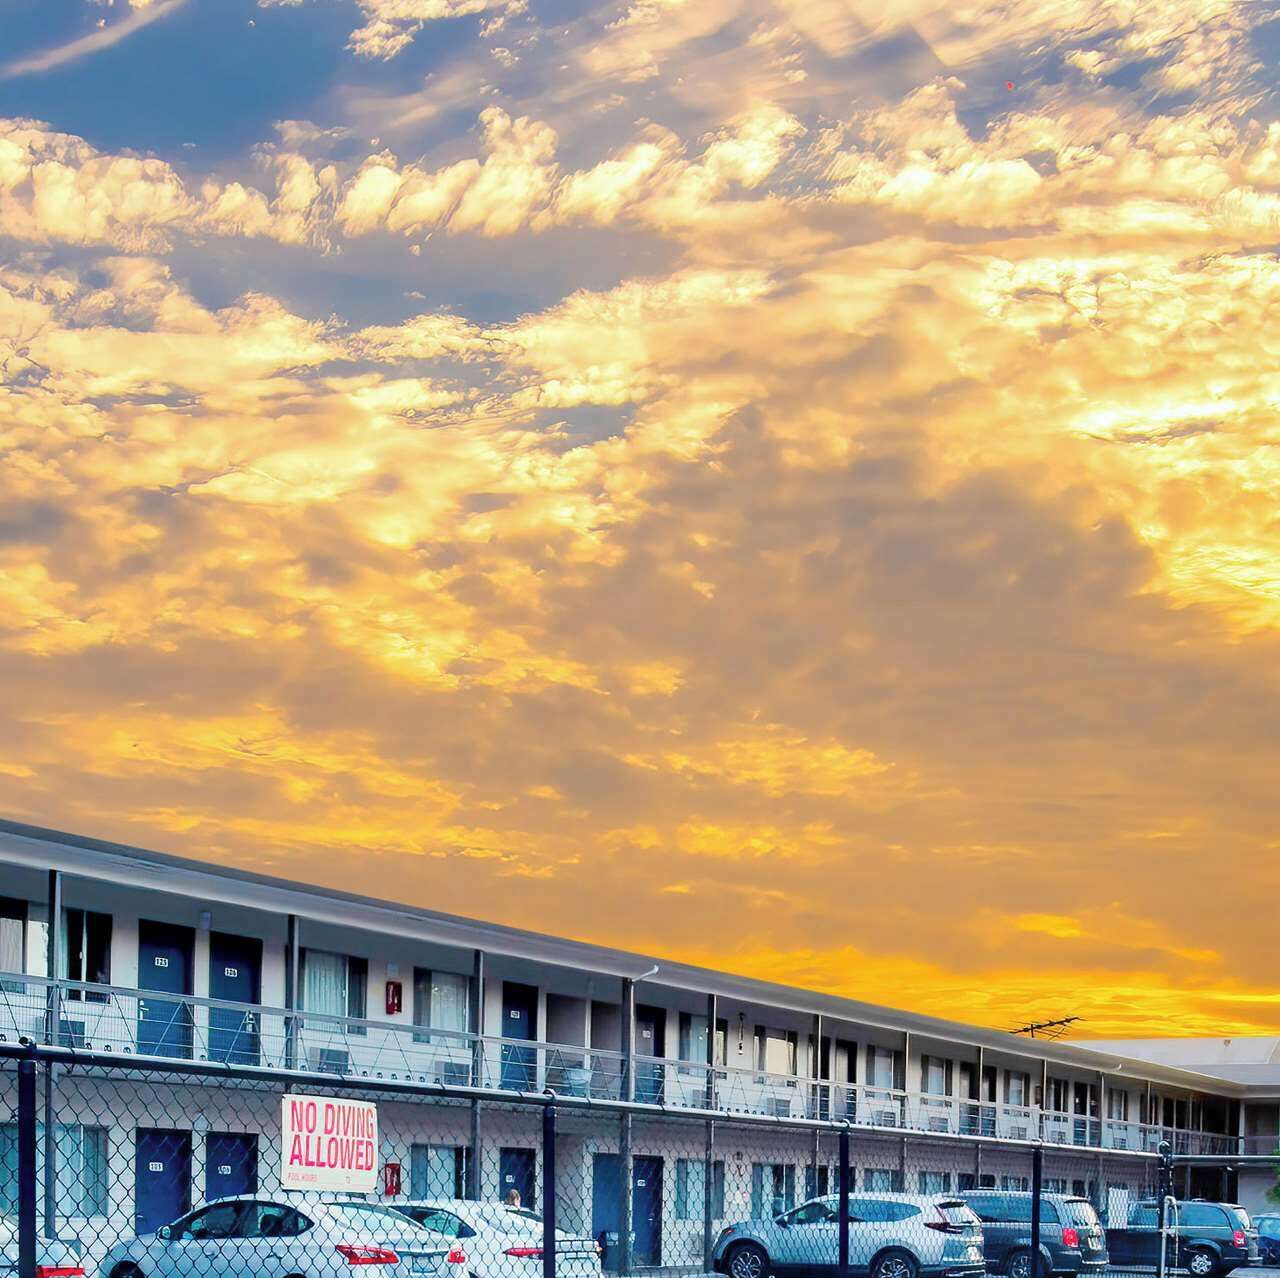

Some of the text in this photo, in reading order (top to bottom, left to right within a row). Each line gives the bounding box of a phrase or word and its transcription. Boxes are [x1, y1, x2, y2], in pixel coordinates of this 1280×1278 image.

[290, 1100, 374, 1139] NO DIVING
[289, 1134, 375, 1171] ALLOWED
